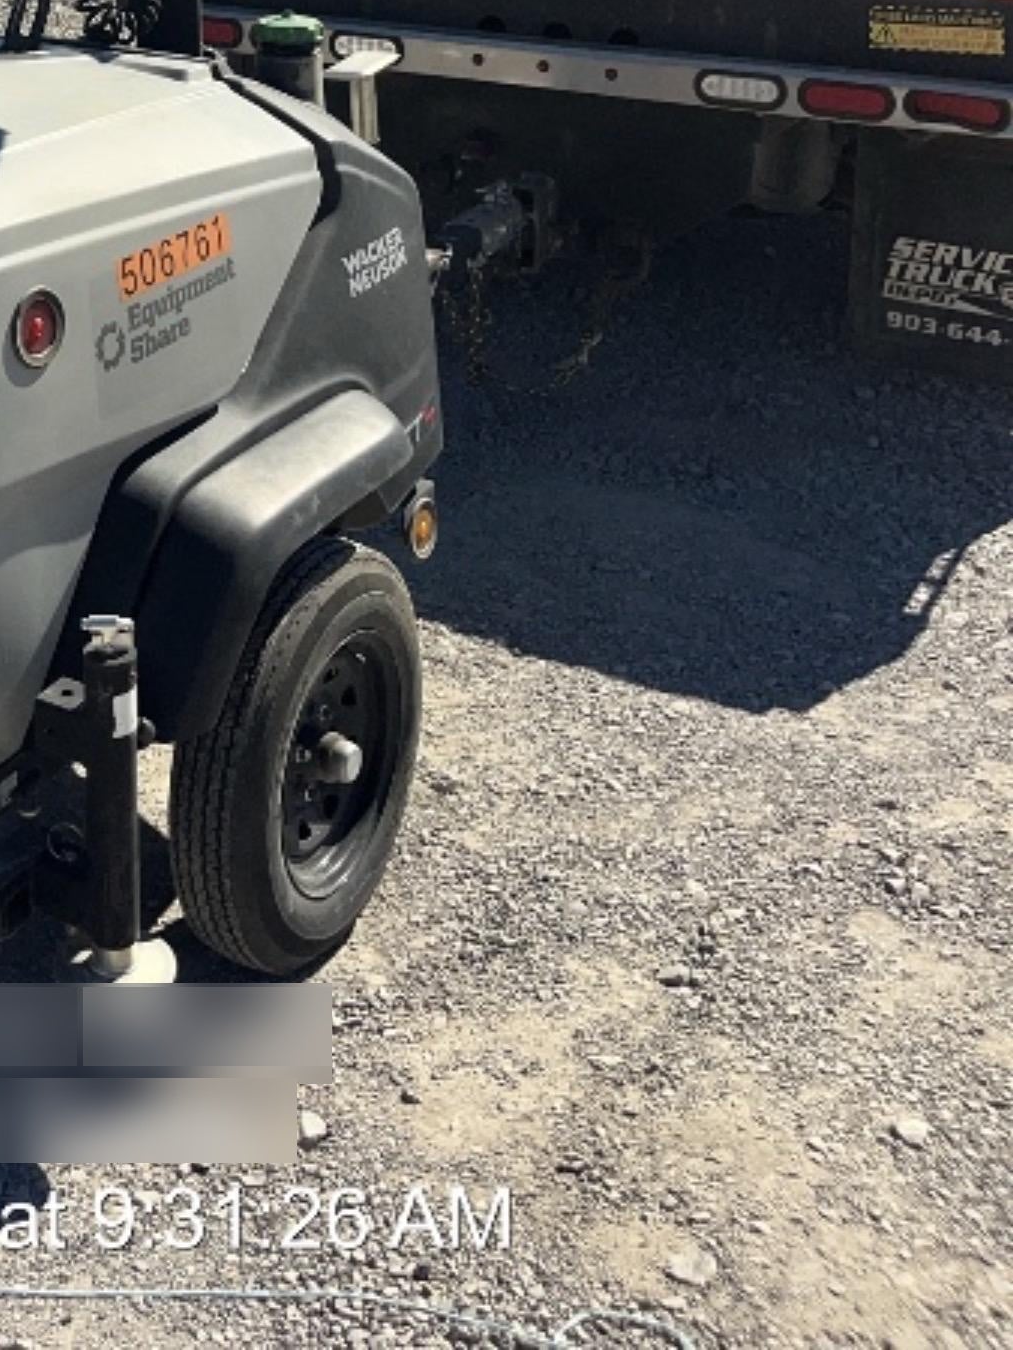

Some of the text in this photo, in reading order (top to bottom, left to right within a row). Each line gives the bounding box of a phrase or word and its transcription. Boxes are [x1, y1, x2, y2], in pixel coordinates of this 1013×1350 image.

[120, 215, 223, 297] 506761
[127, 257, 236, 332] Equipment
[130, 317, 191, 364] Share
